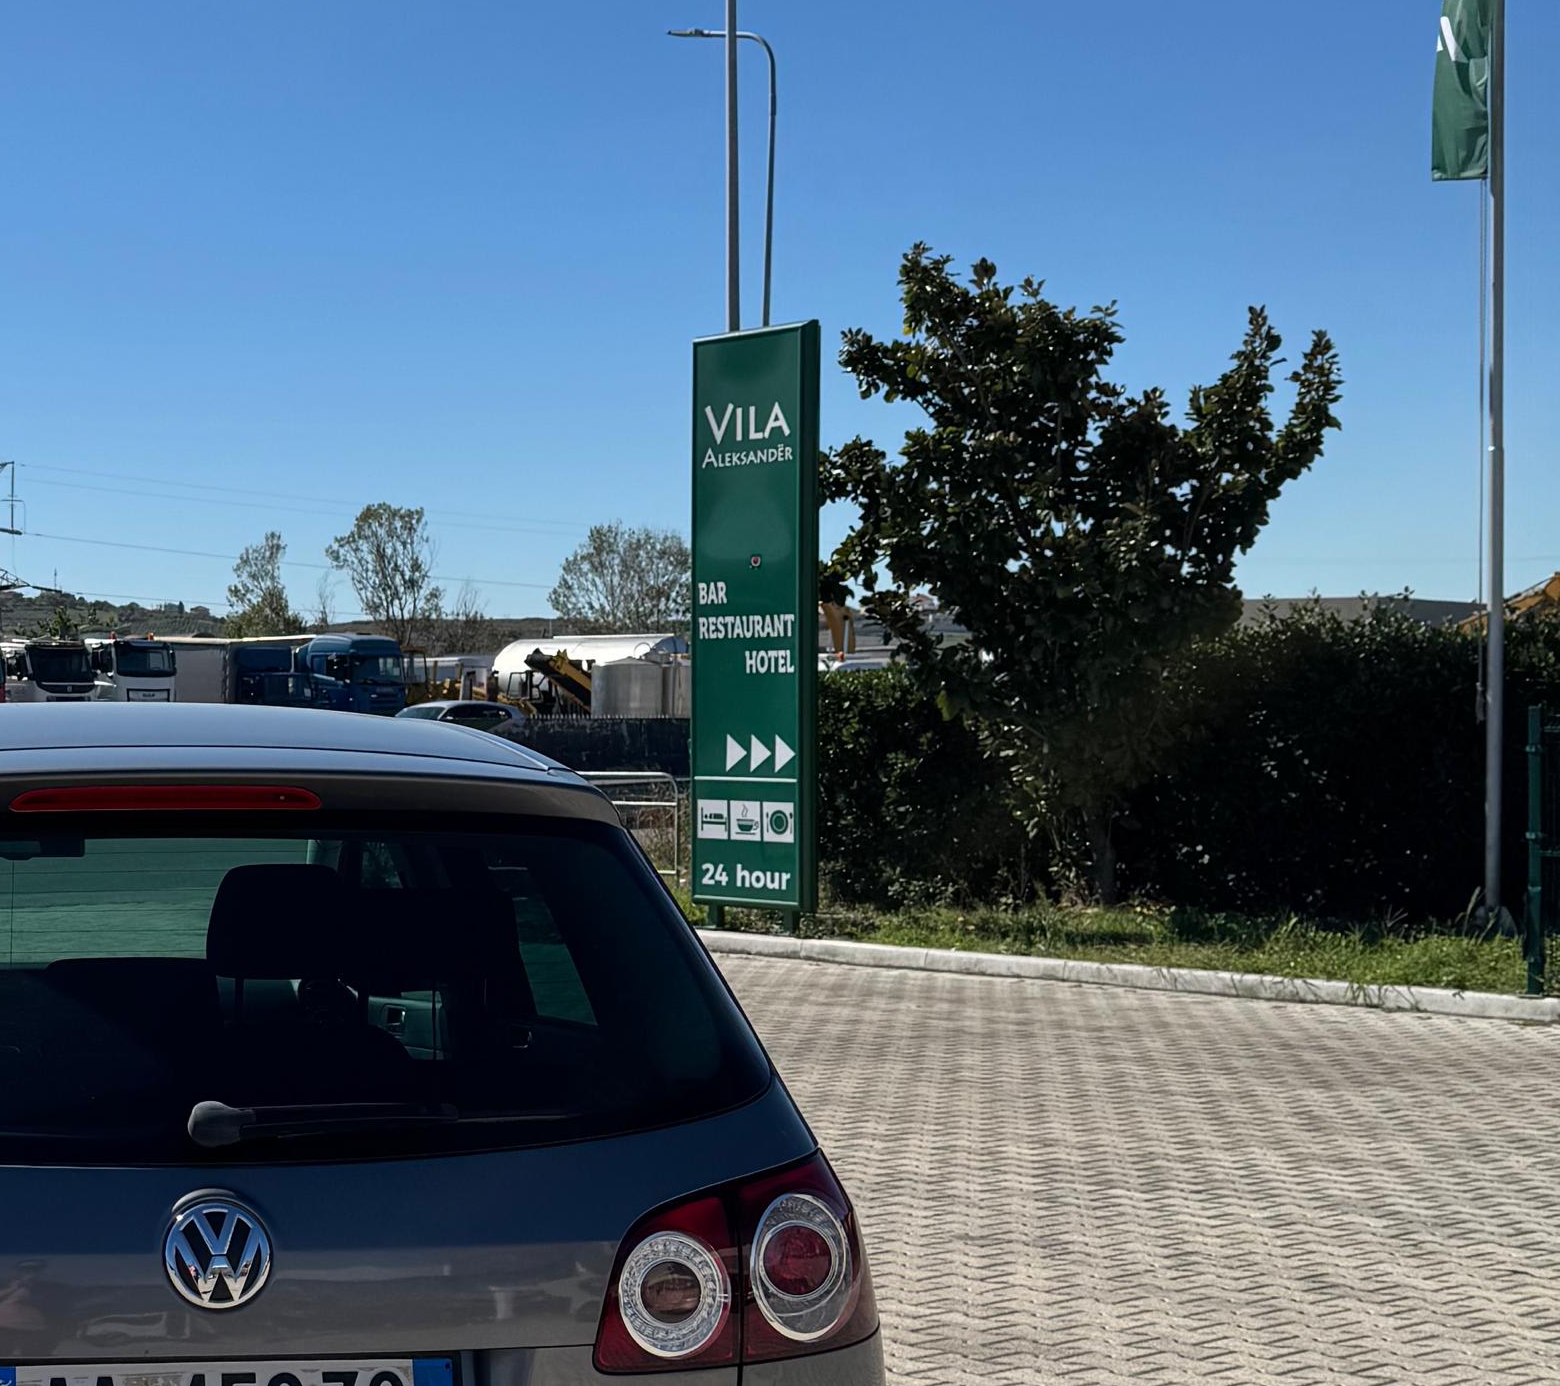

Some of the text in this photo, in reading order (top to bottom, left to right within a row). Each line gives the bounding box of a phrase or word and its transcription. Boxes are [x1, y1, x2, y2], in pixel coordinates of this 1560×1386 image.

[704, 401, 791, 445] VILA
[698, 581, 728, 605] BAR
[698, 614, 795, 639] RESTAURANT
[745, 650, 795, 674] HOTEL
[701, 863, 791, 890] 24 hour
